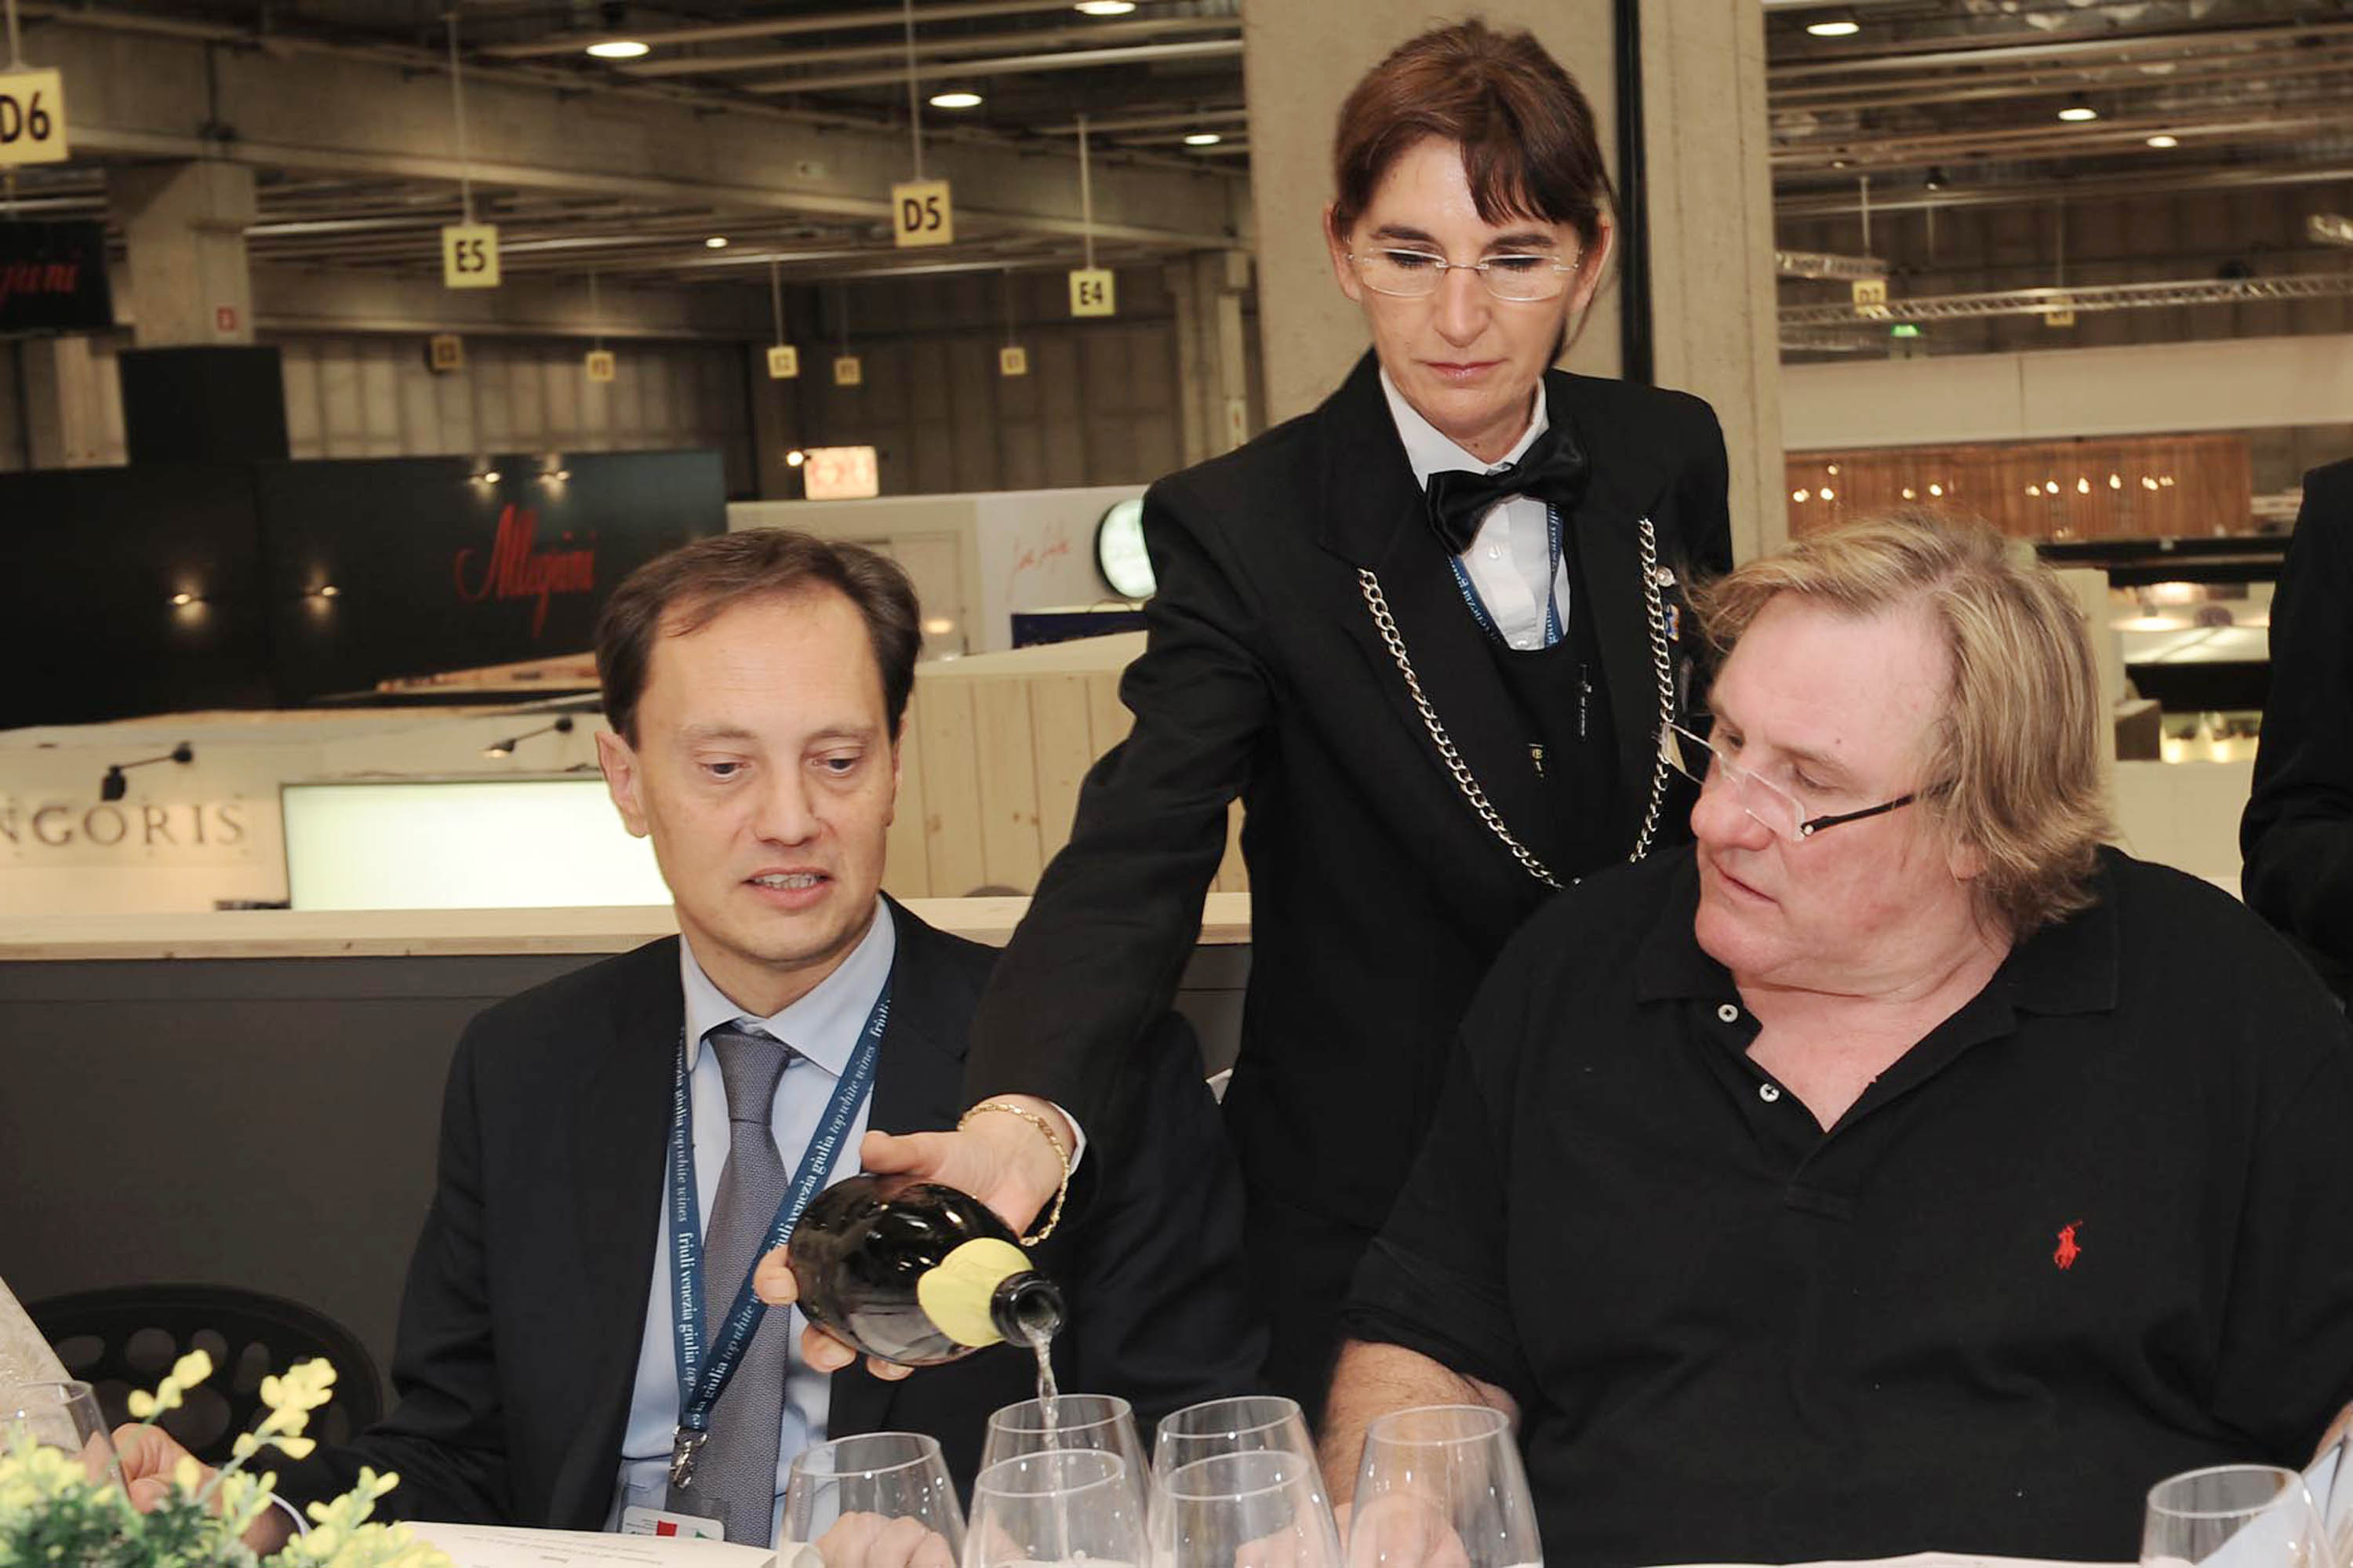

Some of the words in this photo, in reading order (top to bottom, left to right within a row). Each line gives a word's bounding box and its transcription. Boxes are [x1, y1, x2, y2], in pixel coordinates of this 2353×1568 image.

[0, 90, 51, 144] D6
[903, 196, 941, 232] D5
[455, 238, 486, 273] E5
[1079, 281, 1104, 305] E4
[787, 1175, 817, 1224] venezia
[809, 1135, 836, 1175] giulia
[829, 1113, 847, 1134] top
[838, 1079, 860, 1117] white
[855, 1045, 875, 1080] wines
[677, 1187, 691, 1222] wines
[678, 1232, 695, 1268] friuli
[680, 1270, 698, 1320] venezia
[678, 1323, 700, 1363] giulia
